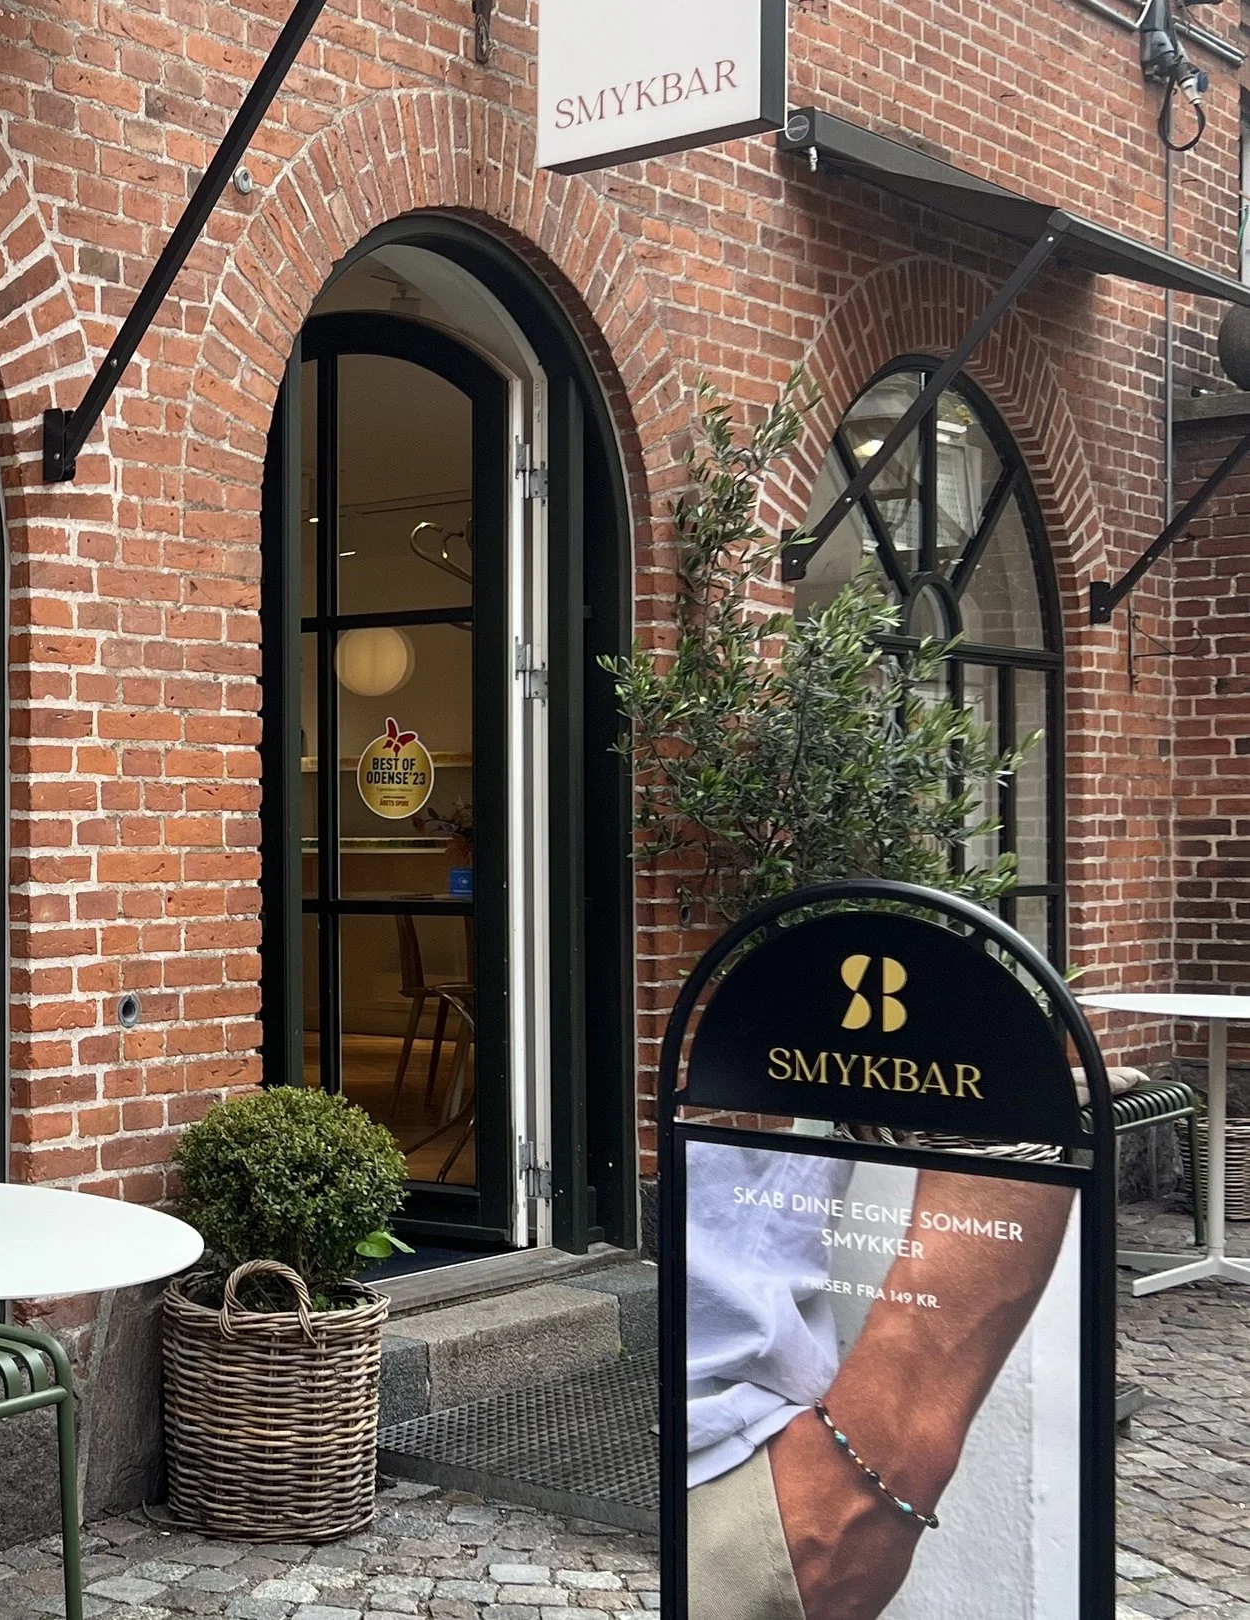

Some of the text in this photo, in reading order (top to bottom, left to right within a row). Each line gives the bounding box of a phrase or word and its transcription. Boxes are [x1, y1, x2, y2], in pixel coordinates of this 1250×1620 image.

[554, 59, 739, 129] SMYKBAR
[372, 757, 416, 771] BEST OF
[767, 1047, 985, 1100] SMYKBAR
[733, 1186, 1023, 1242] SKAB DINE EGNE SOMMER
[820, 1228, 925, 1260] SMYKKER
[802, 1276, 941, 1309] PRISER FRA 149 KR.
